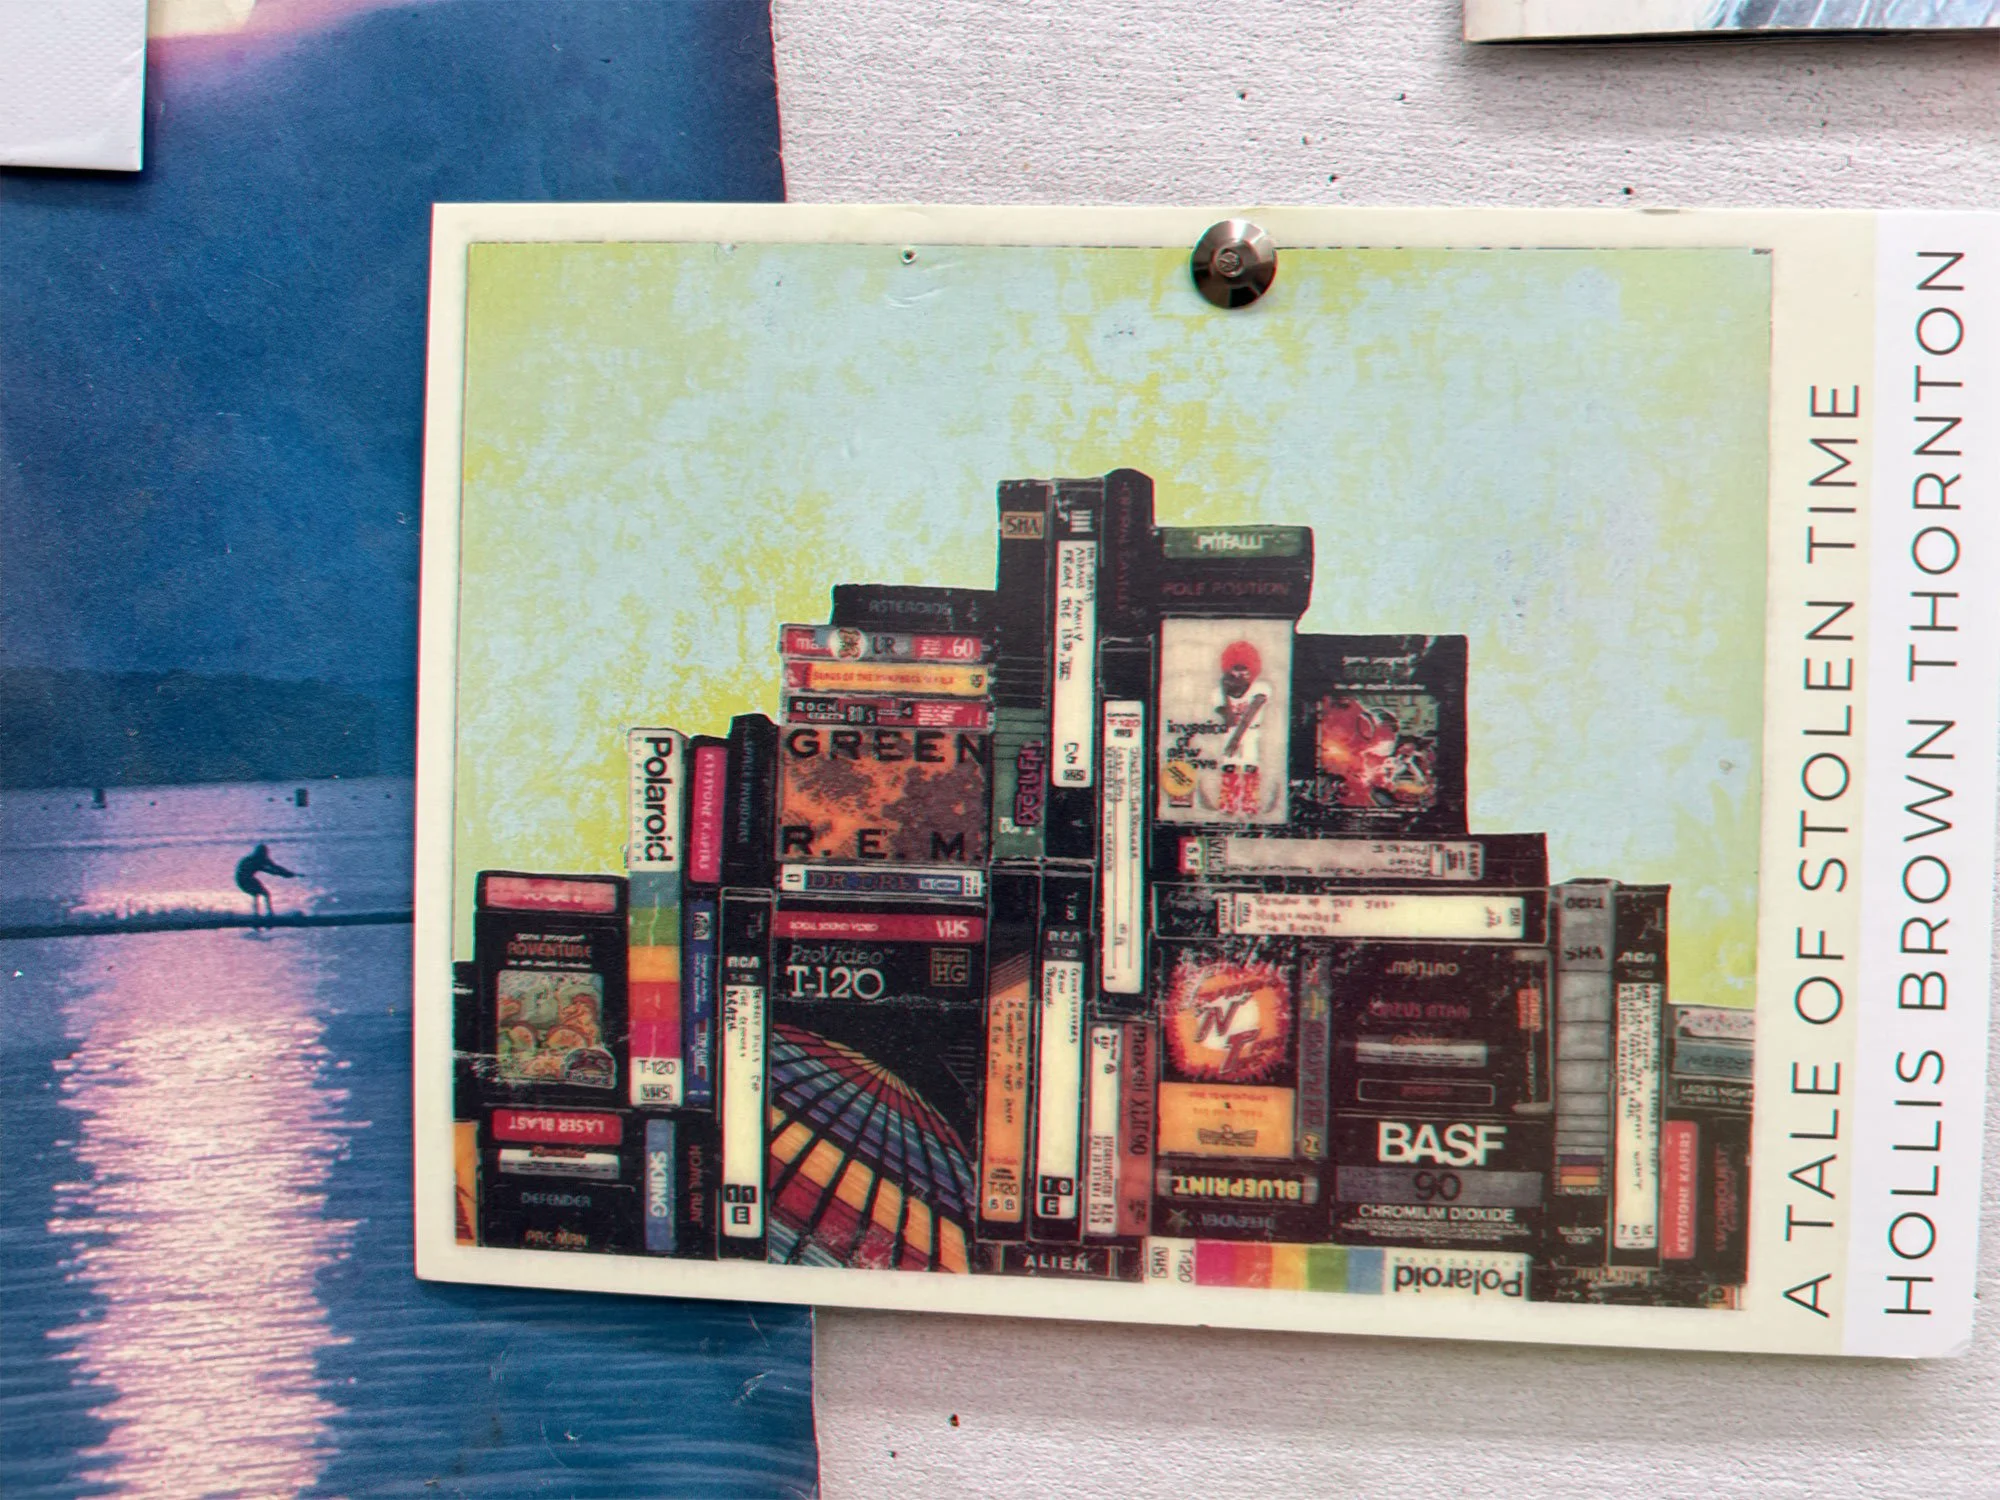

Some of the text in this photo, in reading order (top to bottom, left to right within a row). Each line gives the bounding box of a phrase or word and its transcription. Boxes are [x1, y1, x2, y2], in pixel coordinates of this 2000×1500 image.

[786, 728, 992, 765] GREEN
[643, 736, 675, 862] Polaroid
[700, 752, 716, 818] KEYSTONE
[1885, 252, 1964, 1315] HOLLIS BROWN THORNTON
[1783, 385, 1859, 1318] A TALE OF STOLEN TIME
[935, 920, 969, 939] VHS
[507, 941, 592, 958] ADVENTURE
[786, 965, 886, 1000] T-120
[934, 966, 966, 982] HG
[637, 1059, 675, 1075] T-120
[508, 1115, 605, 1133] LASER BLAST
[1377, 1120, 1507, 1167] BASF
[520, 1191, 593, 1208] DEFENDER
[1173, 1175, 1302, 1201] BLUEPRINT
[1412, 1170, 1462, 1202] 90
[1676, 1131, 1691, 1253] KEYSTONE KAPERS
[1357, 1203, 1515, 1222] CHROMIUM DIOXIDE
[1176, 1247, 1194, 1284] T-120
[1393, 1265, 1525, 1297] Polaroid
